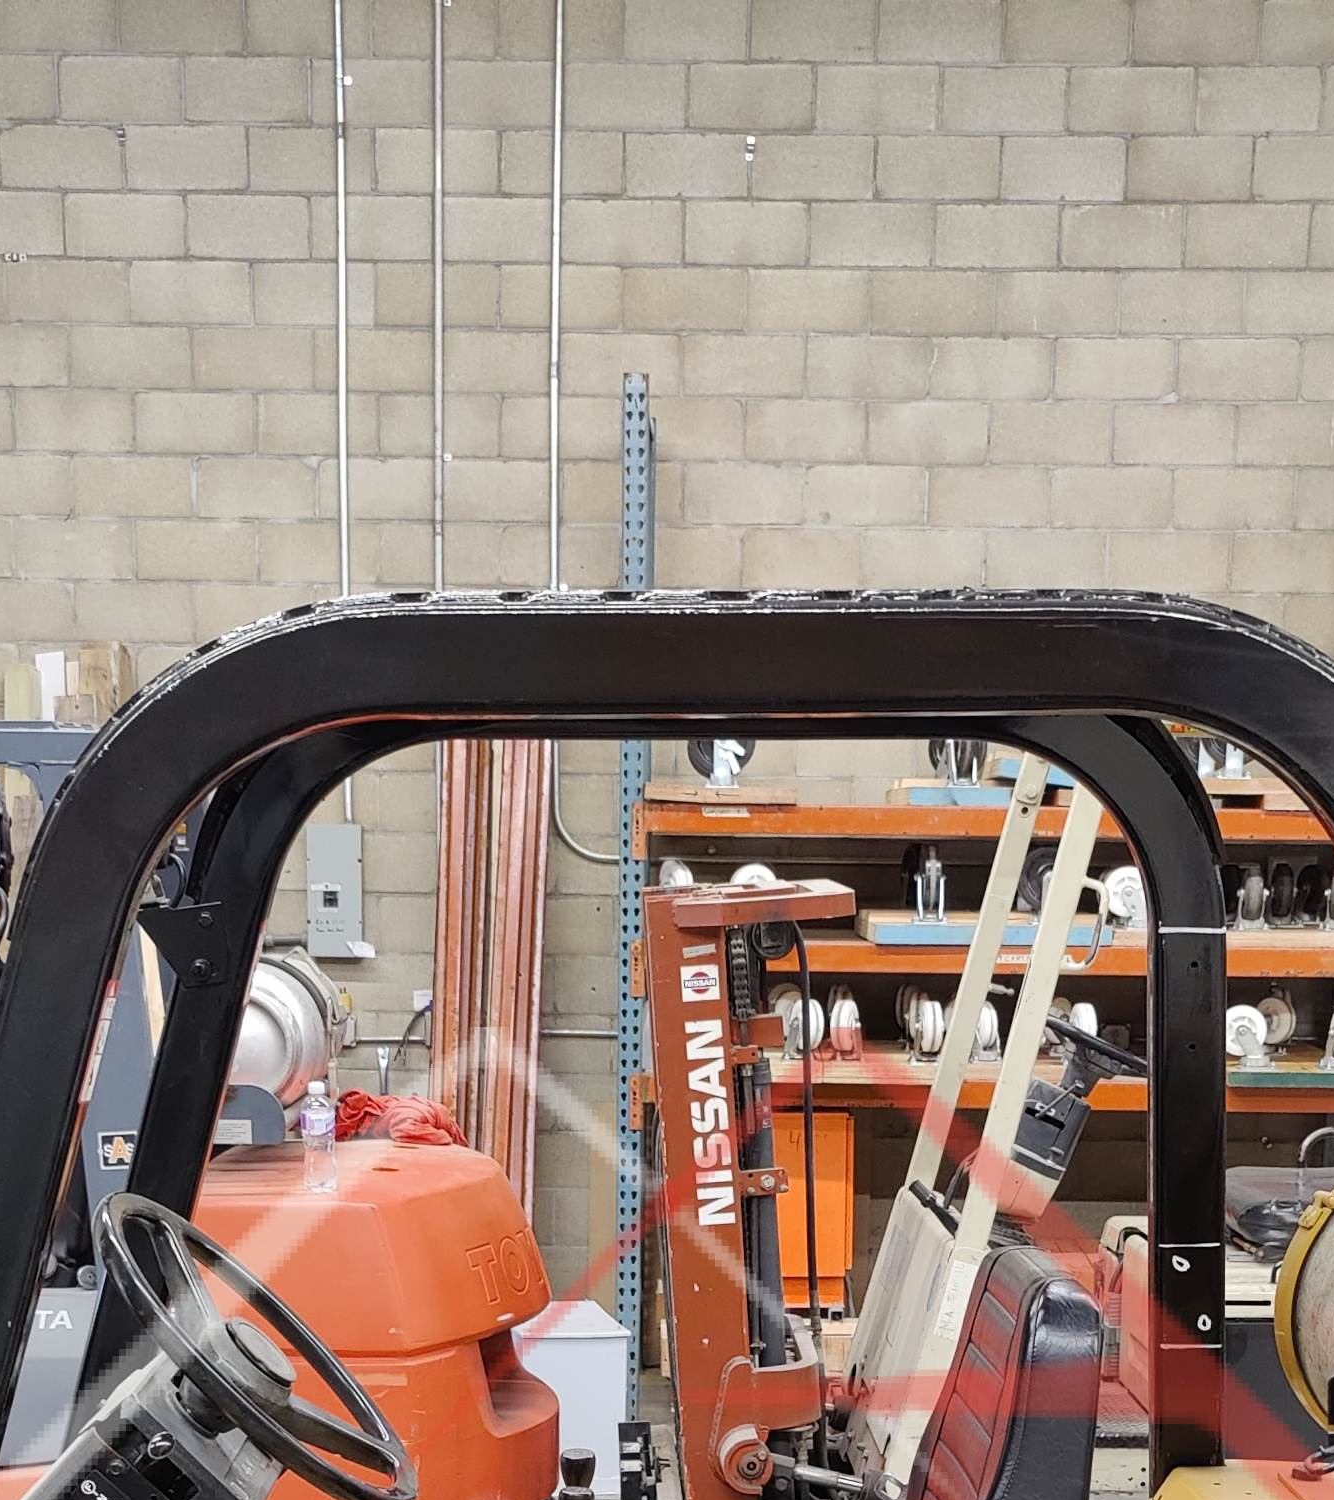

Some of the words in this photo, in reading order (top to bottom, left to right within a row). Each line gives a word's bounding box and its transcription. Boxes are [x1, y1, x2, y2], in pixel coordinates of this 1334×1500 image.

[684, 978, 716, 988] NISSAN
[684, 1019, 736, 1226] NISSAN
[465, 1226, 547, 1305] TOY
